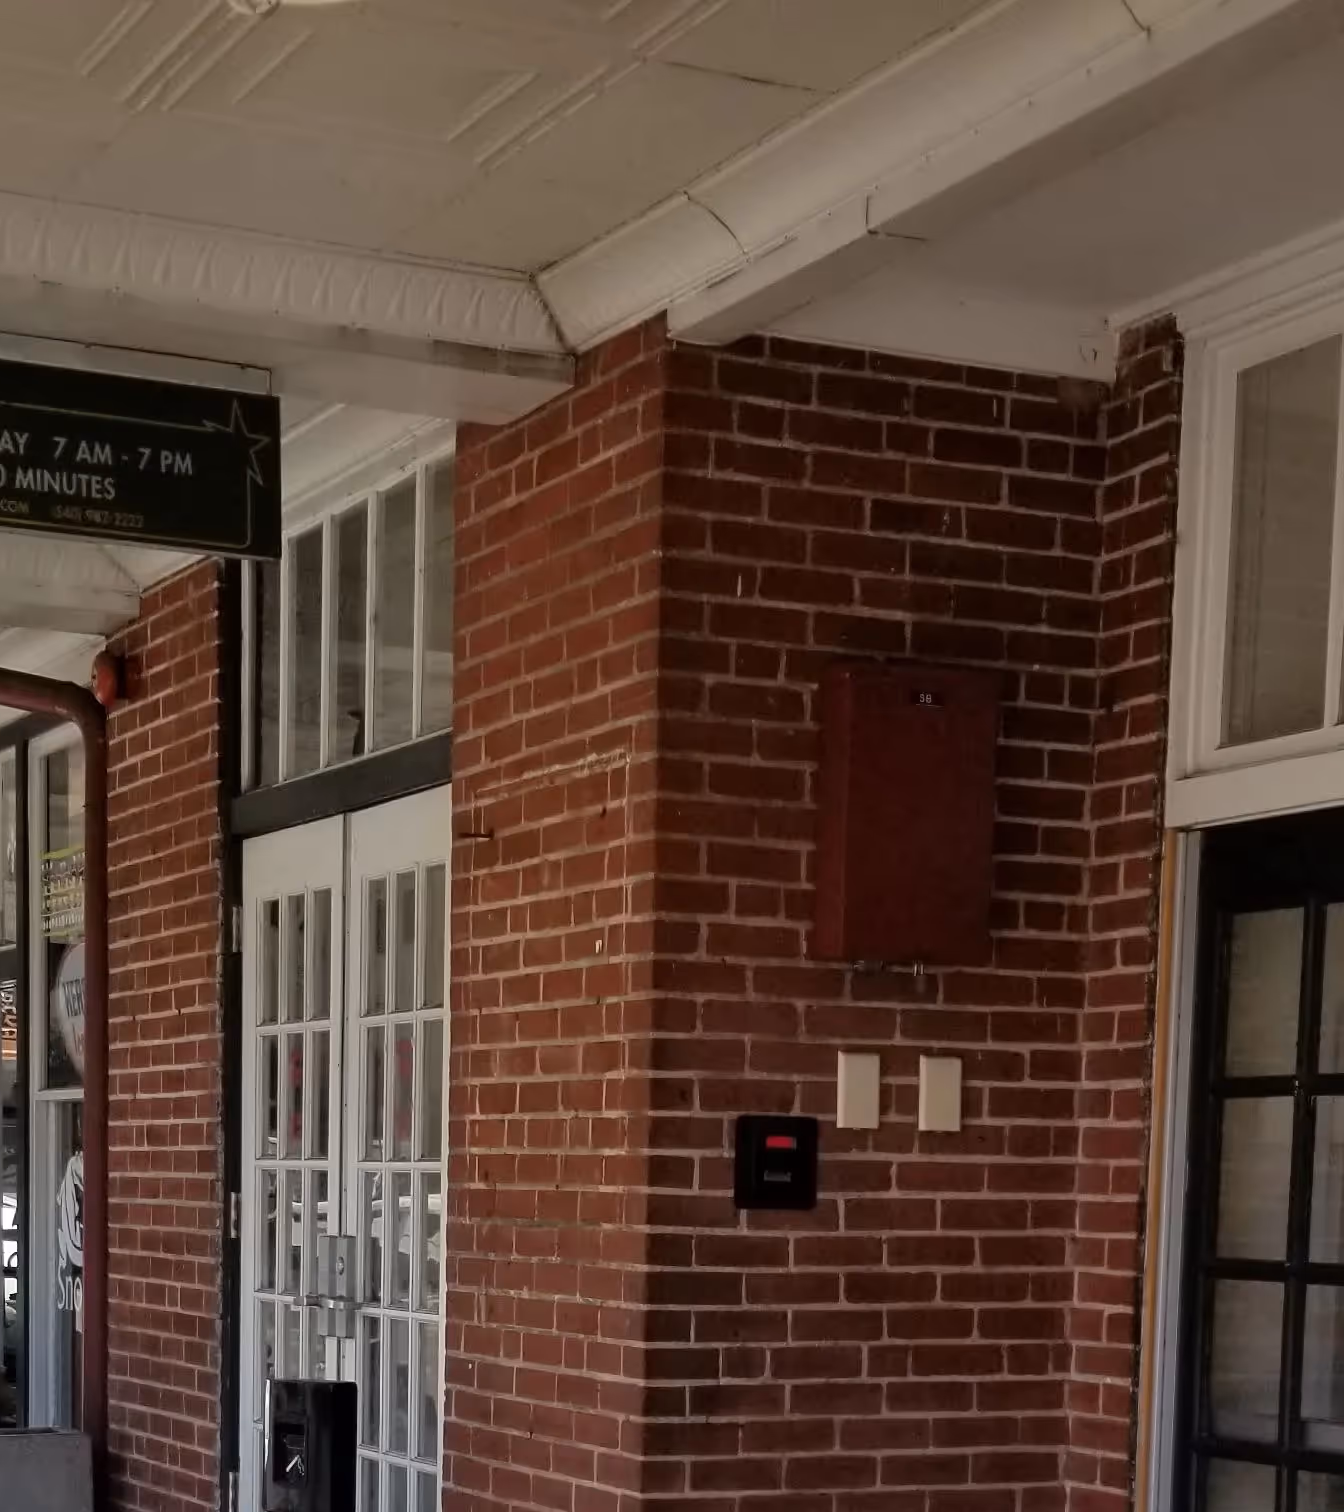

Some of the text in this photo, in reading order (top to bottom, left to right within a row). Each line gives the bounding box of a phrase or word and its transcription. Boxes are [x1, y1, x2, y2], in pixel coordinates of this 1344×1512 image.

[53, 435, 67, 460] 7
[76, 440, 113, 467] AM
[137, 447, 151, 471] 7
[160, 449, 194, 476] PM
[15, 464, 117, 500] MINUTES
